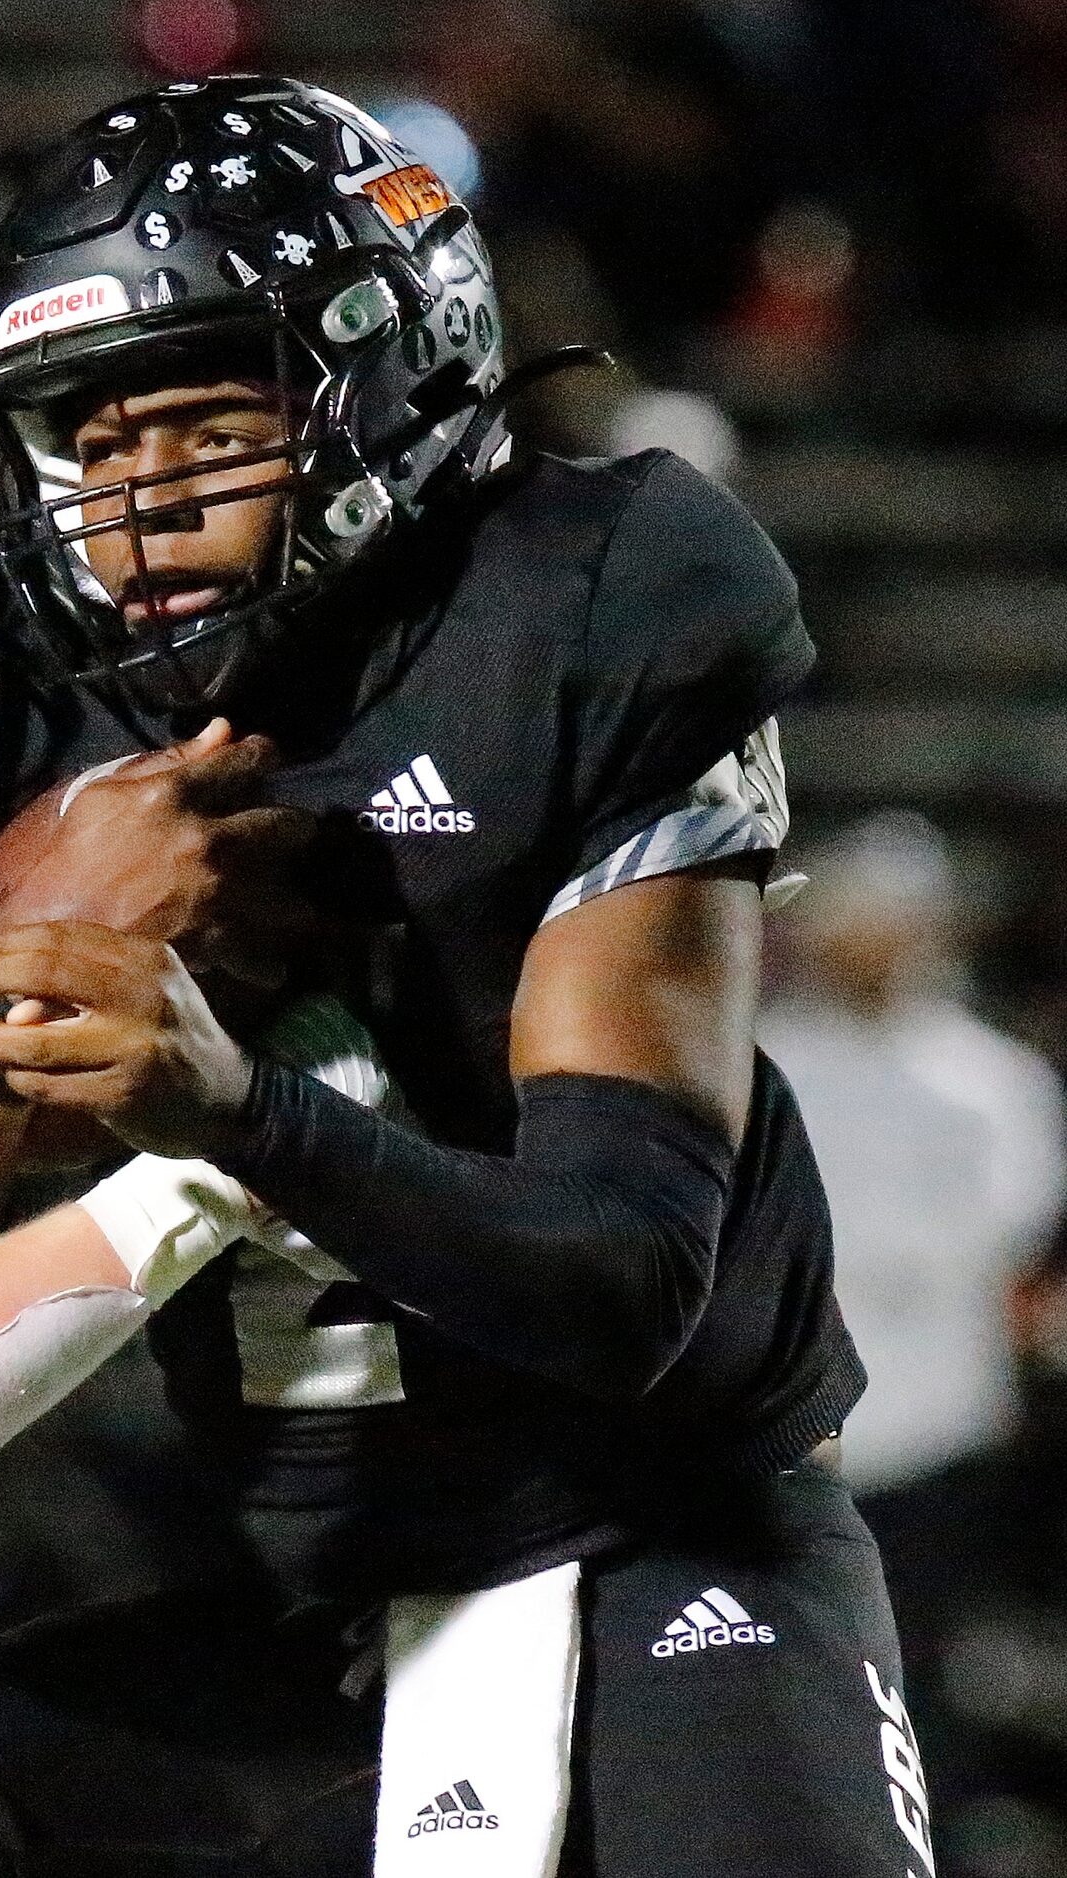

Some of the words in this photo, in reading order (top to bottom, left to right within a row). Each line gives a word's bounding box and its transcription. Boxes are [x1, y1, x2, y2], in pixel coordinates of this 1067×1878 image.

[6, 287, 105, 335] Riddell
[357, 803, 476, 834] adidas
[651, 1622, 776, 1658] adidas
[407, 1811, 499, 1838] adidas
